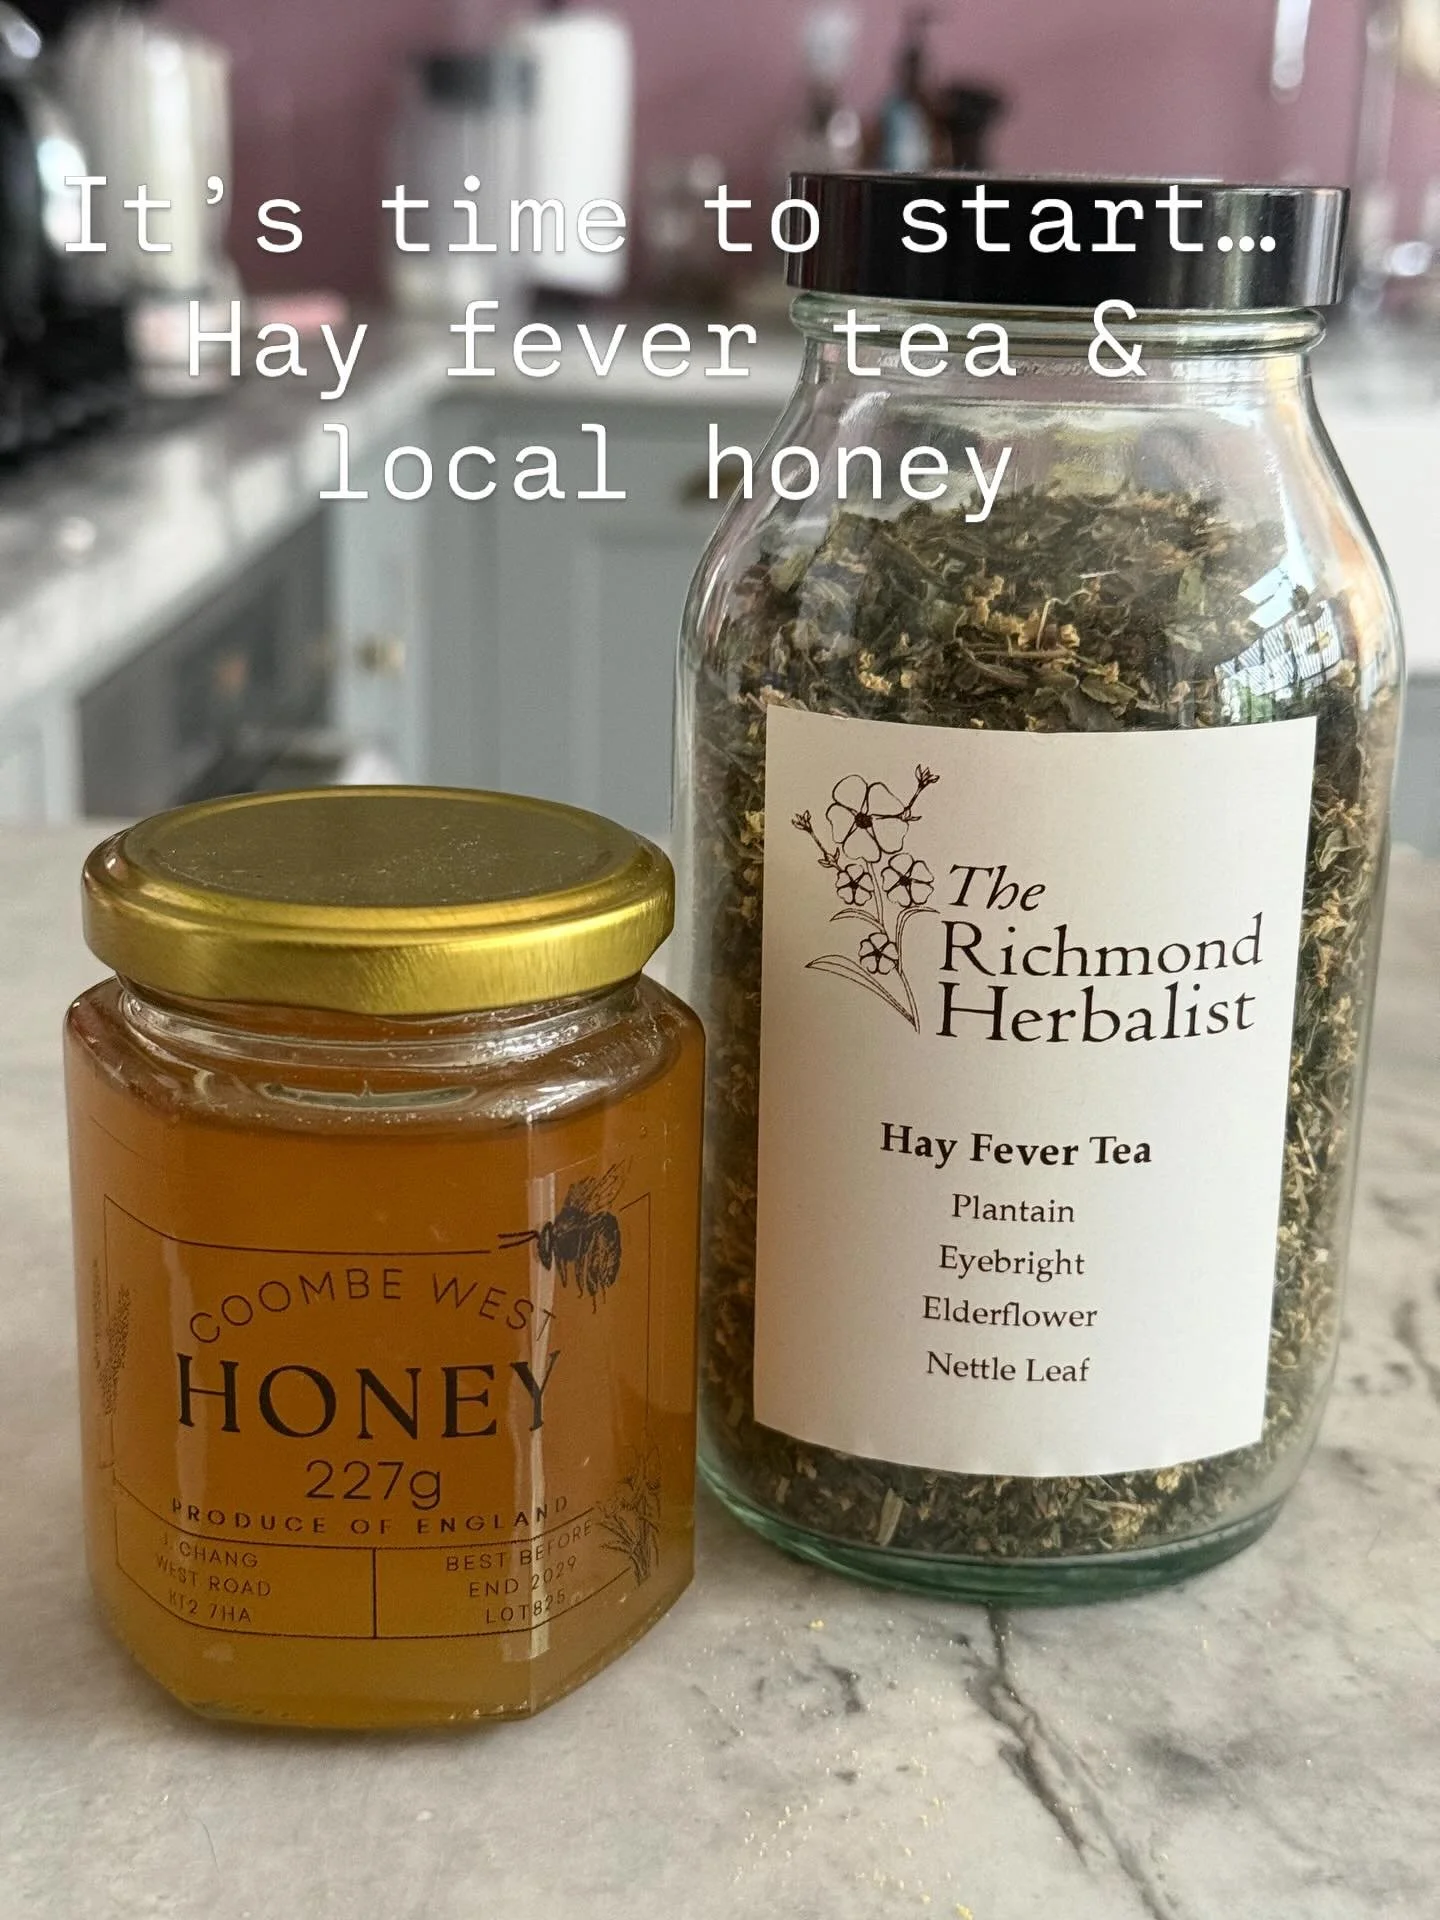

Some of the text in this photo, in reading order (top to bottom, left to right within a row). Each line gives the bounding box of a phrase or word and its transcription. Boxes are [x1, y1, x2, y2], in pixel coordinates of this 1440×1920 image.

[948, 864, 1046, 912] The
[940, 912, 1263, 977] Richmond
[936, 981, 1257, 1043] Herbalist
[880, 1122, 1152, 1169] Hay Fever Tea
[951, 1193, 1076, 1223] Plantain
[938, 1244, 1086, 1283] Eyebright
[189, 1268, 557, 1343] COOMBE WEST
[921, 1295, 1098, 1327] Elderflower
[926, 1350, 1091, 1383] Nettle Leaf
[176, 1350, 560, 1440] HONEY
[305, 1458, 441, 1511] 227g
[171, 1496, 568, 1536] PRODUCE OF ENGLAND
[178, 1540, 259, 1569] CHANG
[446, 1519, 593, 1572] BEST BEFORE
[155, 1553, 272, 1598] WEST ROAD
[469, 1555, 577, 1598] END 2029
[209, 1603, 252, 1624] 7HA
